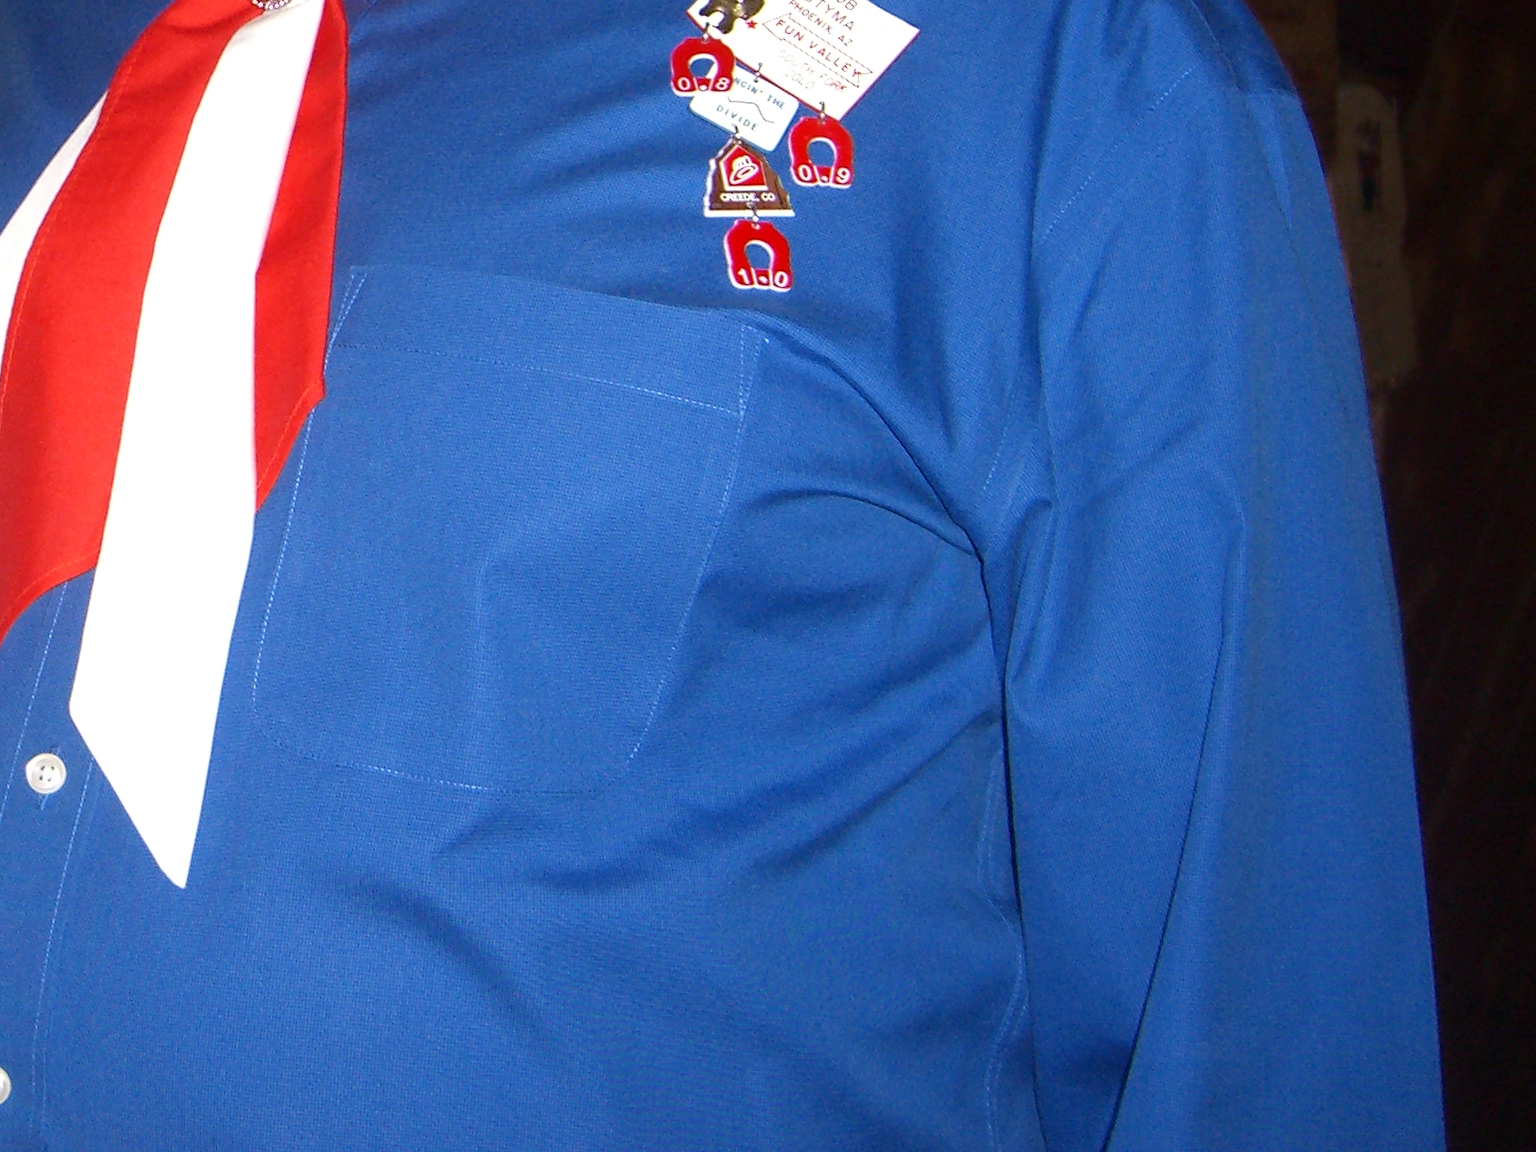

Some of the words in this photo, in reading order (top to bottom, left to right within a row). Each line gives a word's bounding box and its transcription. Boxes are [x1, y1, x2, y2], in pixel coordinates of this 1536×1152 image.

[774, 17, 804, 43] FUN
[808, 40, 864, 80] VALLEY
[777, 49, 815, 79] SOUTH
[716, 103, 761, 134] DIVIDE
